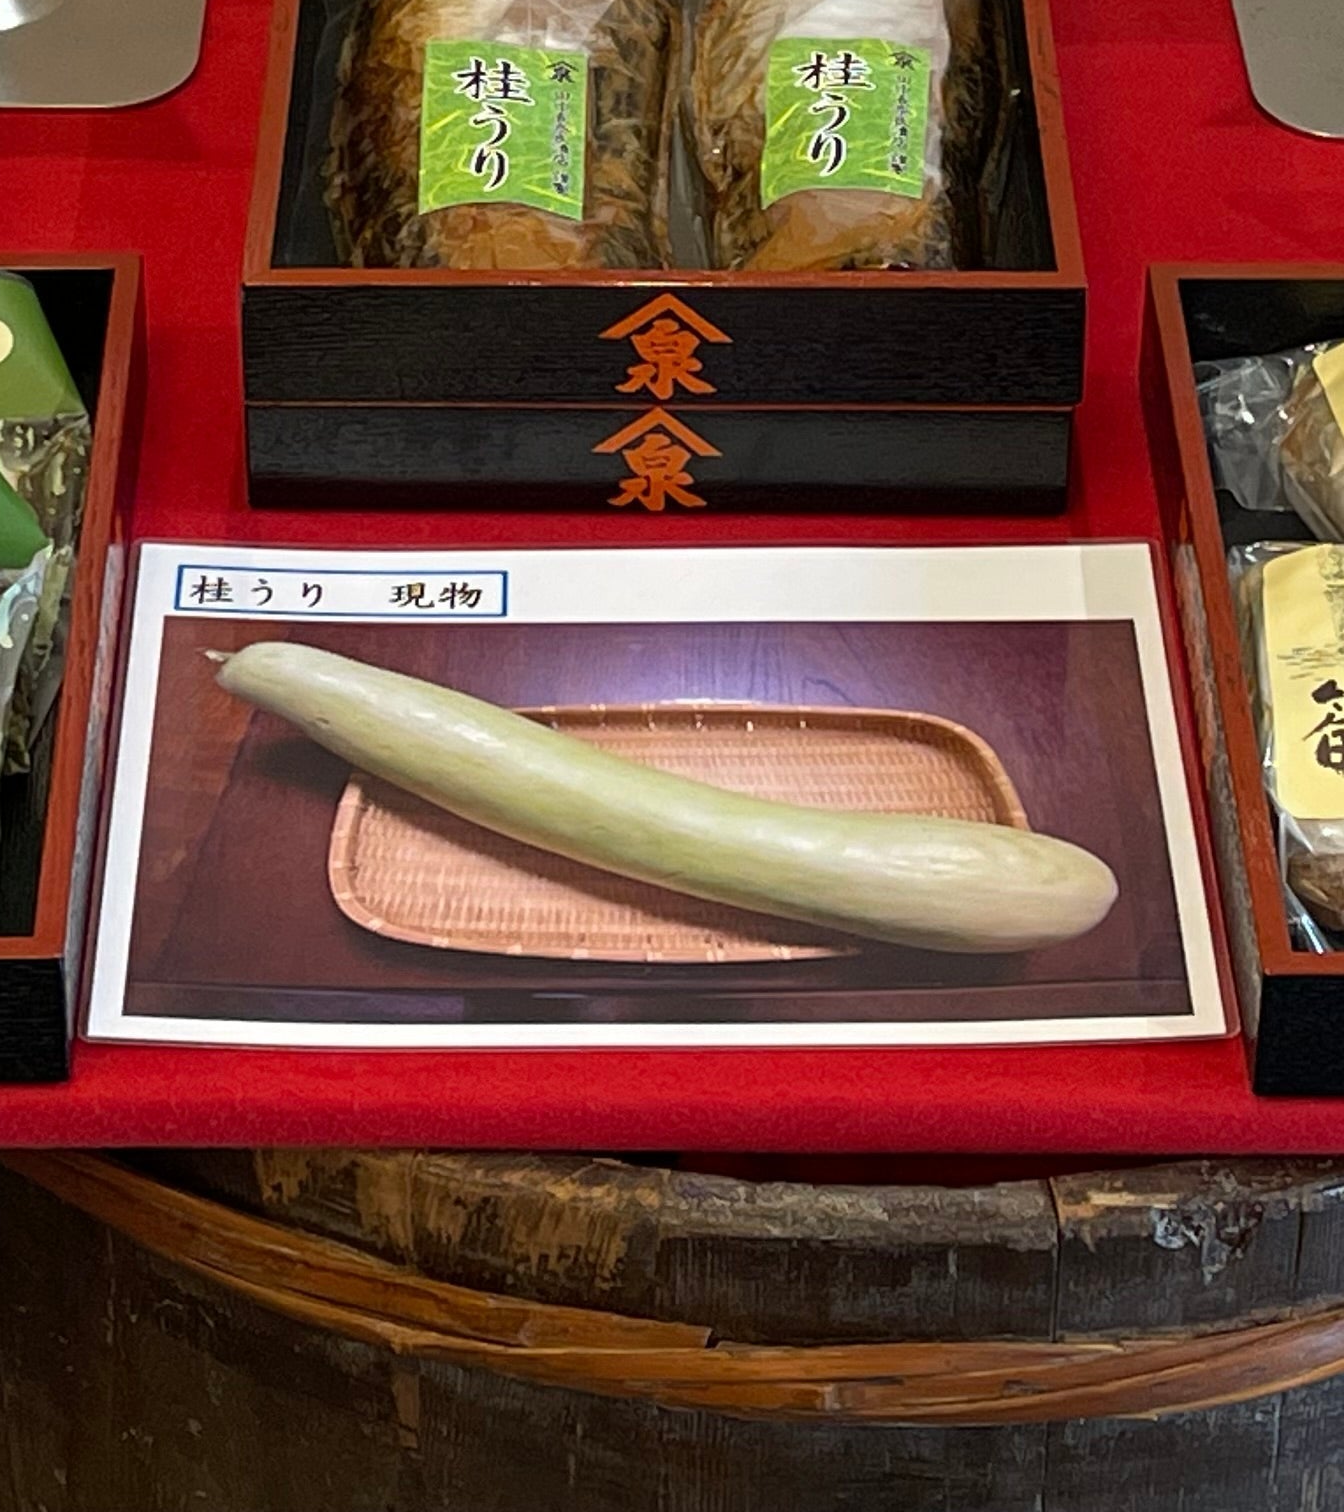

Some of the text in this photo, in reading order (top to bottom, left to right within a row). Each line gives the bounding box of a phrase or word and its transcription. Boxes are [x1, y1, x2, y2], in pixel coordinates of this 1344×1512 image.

[455, 57, 534, 190] 桂うり
[795, 50, 876, 177] 桂うり
[190, 575, 484, 610] 桂うり 現物
